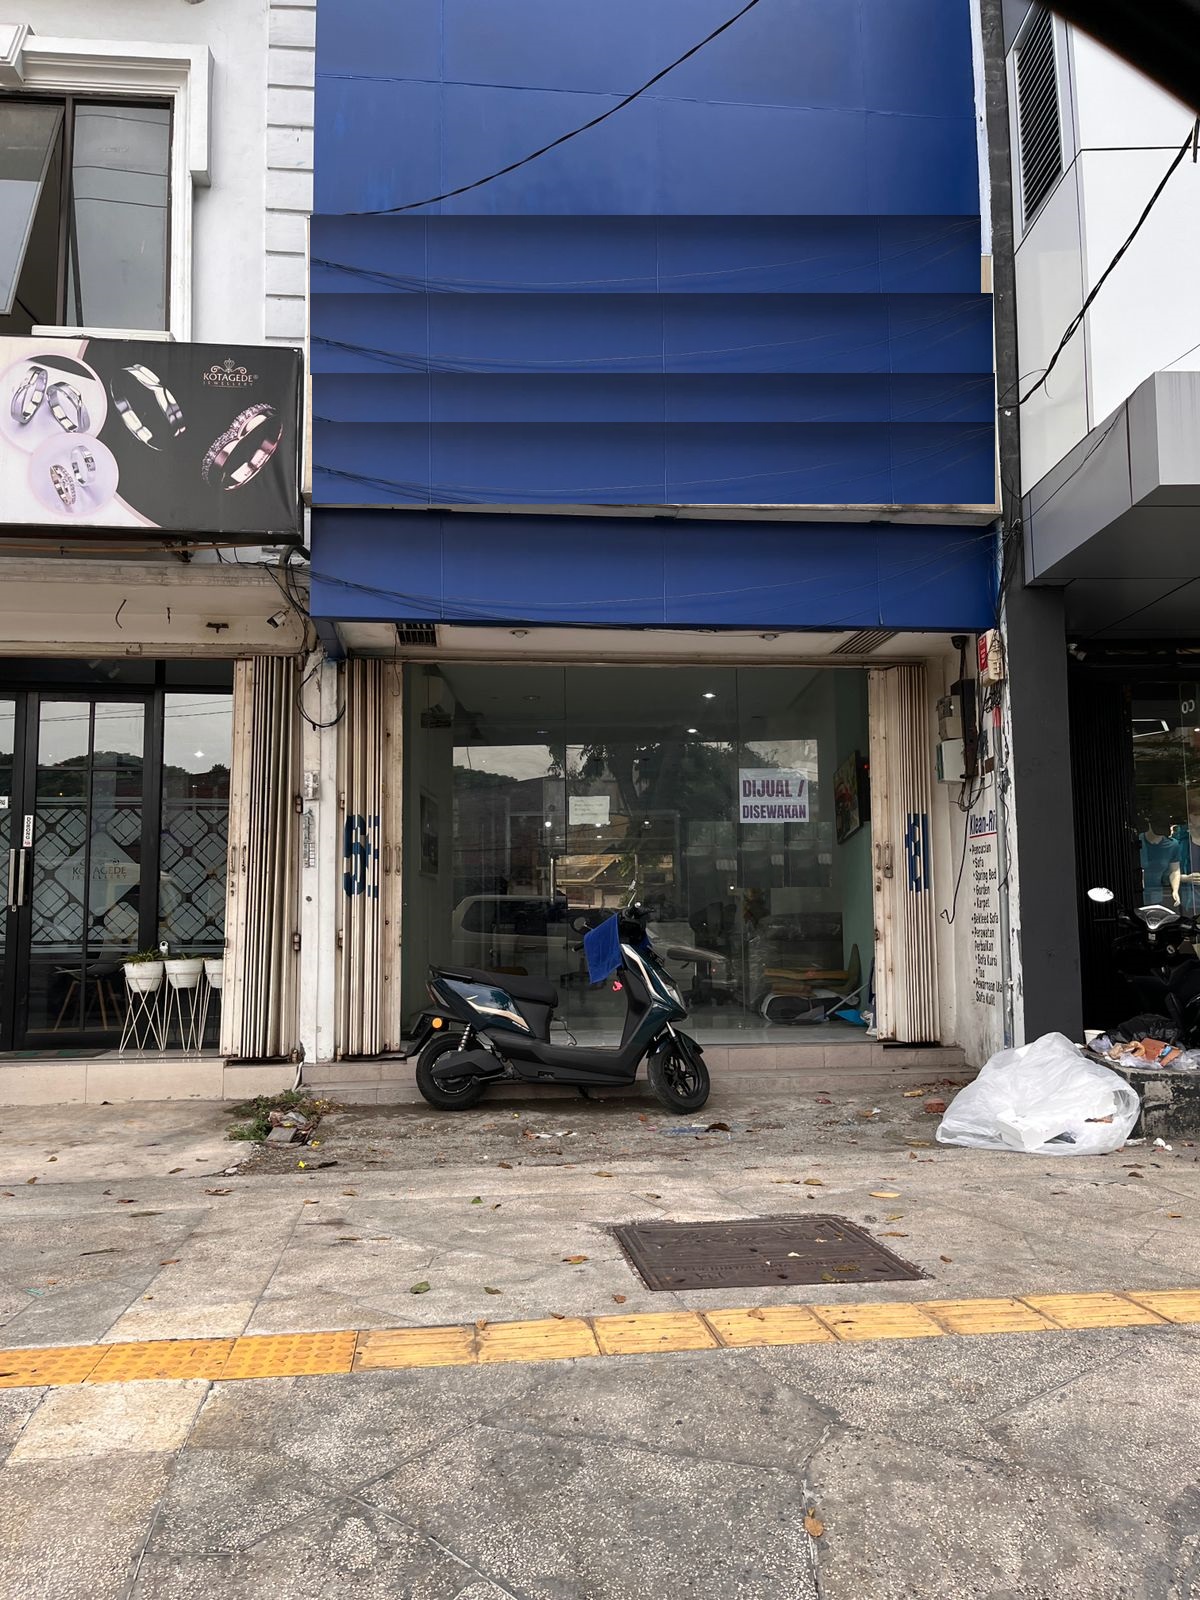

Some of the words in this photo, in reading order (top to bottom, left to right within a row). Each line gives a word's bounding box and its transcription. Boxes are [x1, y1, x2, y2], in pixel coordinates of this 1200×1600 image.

[203, 372, 254, 383] KOTAGEDE
[742, 779, 793, 798] DIJUAL
[797, 779, 805, 797] /
[742, 804, 807, 819] DISEWAKAN
[974, 857, 984, 868] Sofa
[975, 869, 988, 884] Spring
[988, 867, 997, 880] Bed
[976, 897, 990, 911] Karpet
[989, 911, 999, 924] Sofa
[974, 926, 995, 938] Perawatan
[977, 953, 987, 966] Sofa
[987, 953, 998, 967] Kursi
[976, 991, 985, 1003] Sofa
